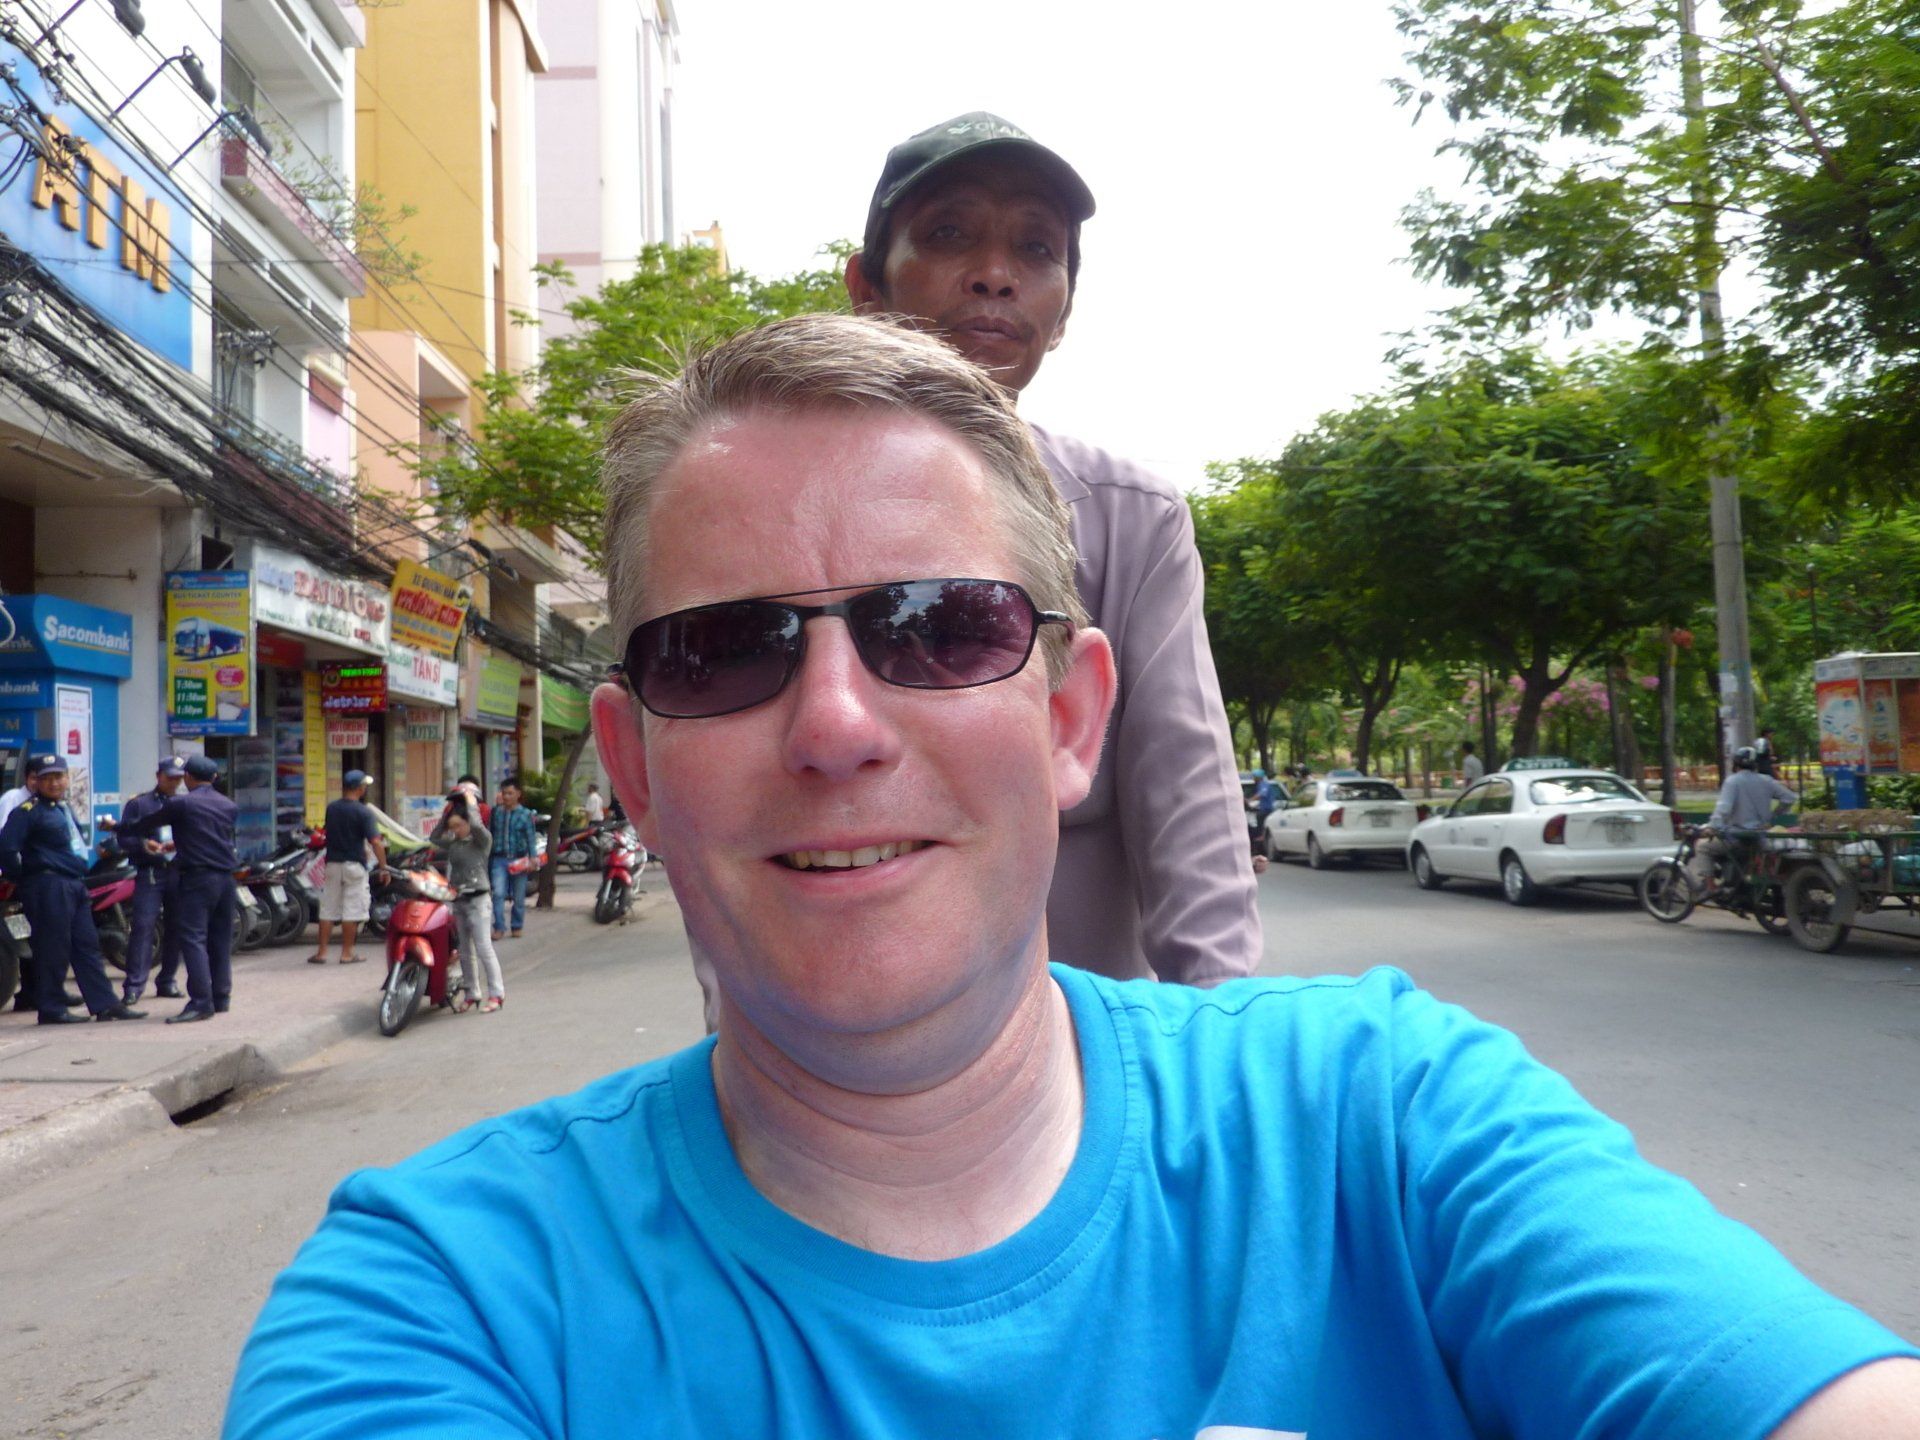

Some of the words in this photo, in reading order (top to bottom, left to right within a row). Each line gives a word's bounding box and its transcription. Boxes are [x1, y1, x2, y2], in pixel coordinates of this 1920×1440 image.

[32, 113, 171, 293] ATM
[44, 615, 131, 651] Sacombank
[332, 733, 345, 747] FOR
[346, 733, 364, 747] RENT
[408, 724, 440, 740] HOTEL
